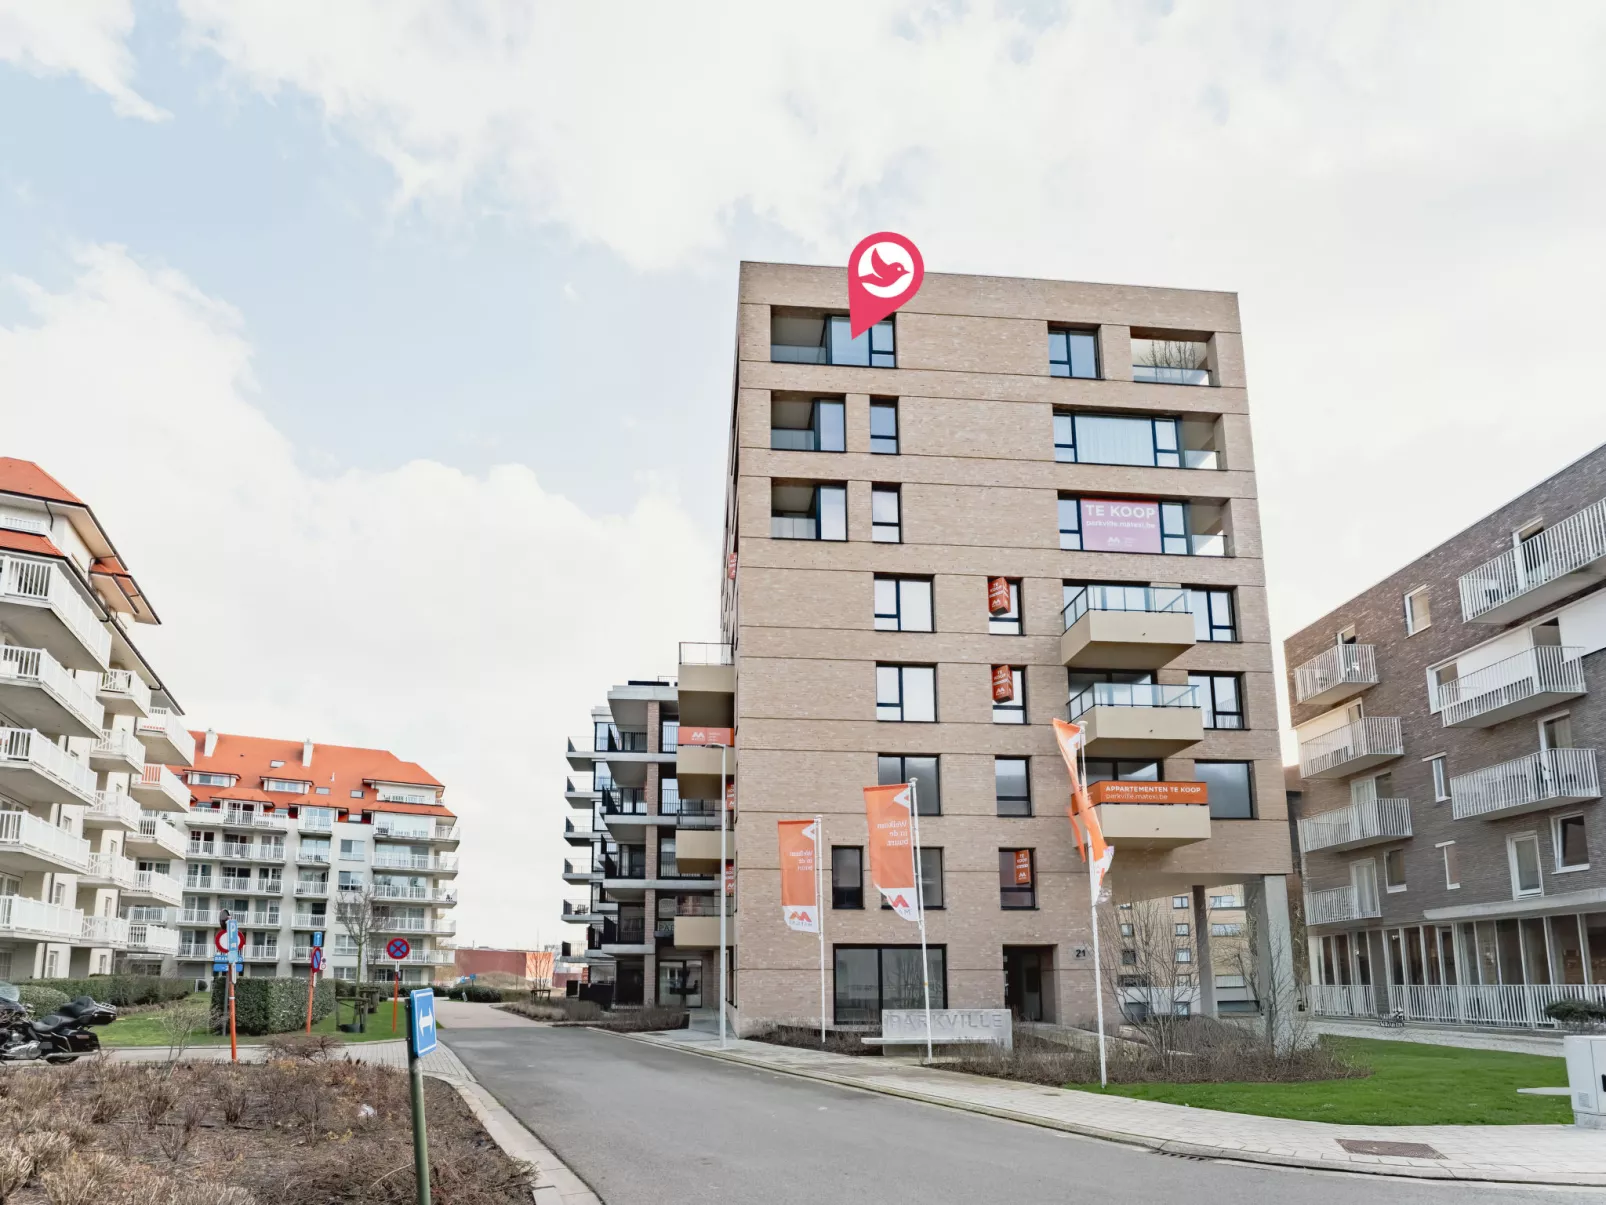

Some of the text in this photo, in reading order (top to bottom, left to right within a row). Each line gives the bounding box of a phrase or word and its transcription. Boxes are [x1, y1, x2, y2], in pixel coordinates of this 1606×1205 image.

[1085, 504, 1156, 519] TE KOOP
[1105, 785, 1169, 793] APPARTEMENTEN
[1180, 786, 1202, 794] KOOP
[1105, 793, 1169, 801] parkville.matexi.be
[230, 921, 236, 939] P
[1075, 949, 1086, 958] 21
[885, 1013, 1003, 1029] PARKVILLE
